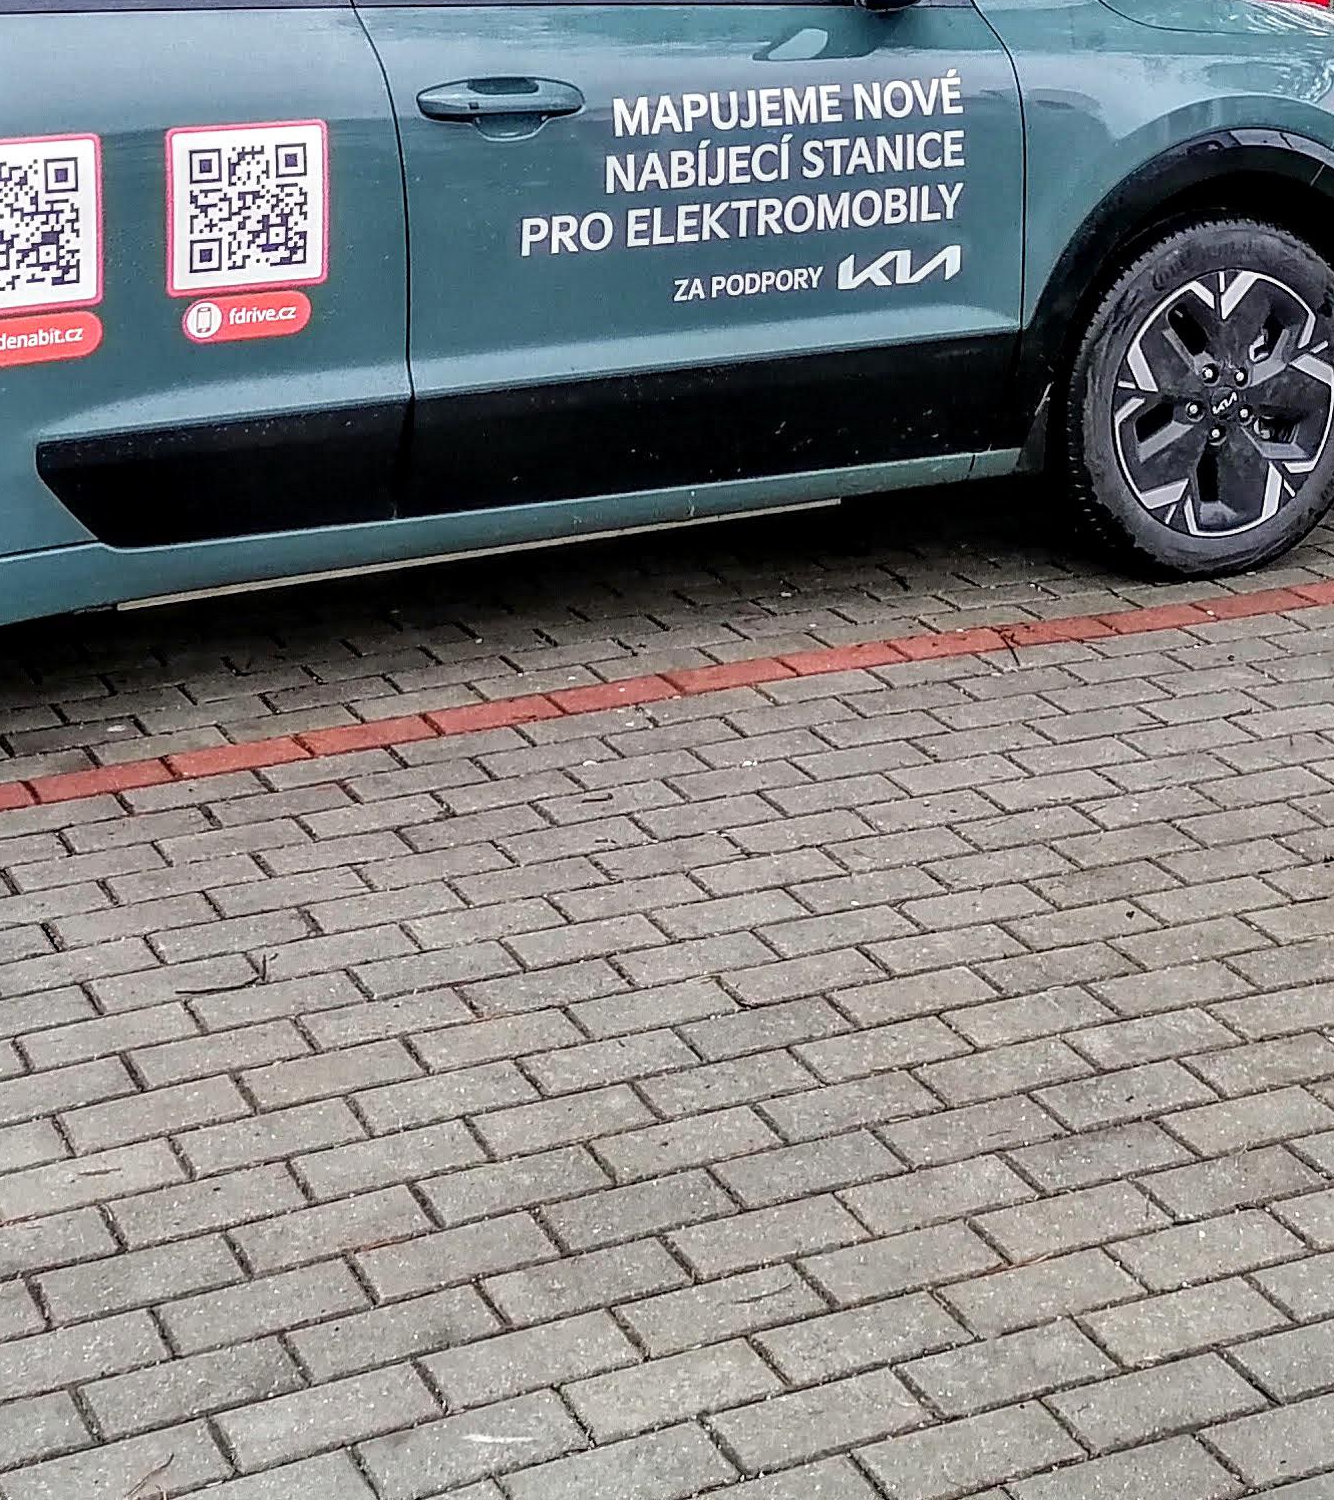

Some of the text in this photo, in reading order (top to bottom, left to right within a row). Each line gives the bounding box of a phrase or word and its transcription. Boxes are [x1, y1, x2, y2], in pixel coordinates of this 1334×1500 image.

[612, 69, 965, 137] MAPUJEME NOVÉ
[605, 130, 966, 194] NABÍJECÍ STANICE
[520, 182, 965, 257] PRO ELEKTROMOBILY
[673, 244, 962, 302] ZA PODPORY KIA
[228, 305, 297, 325] fdrive.cz
